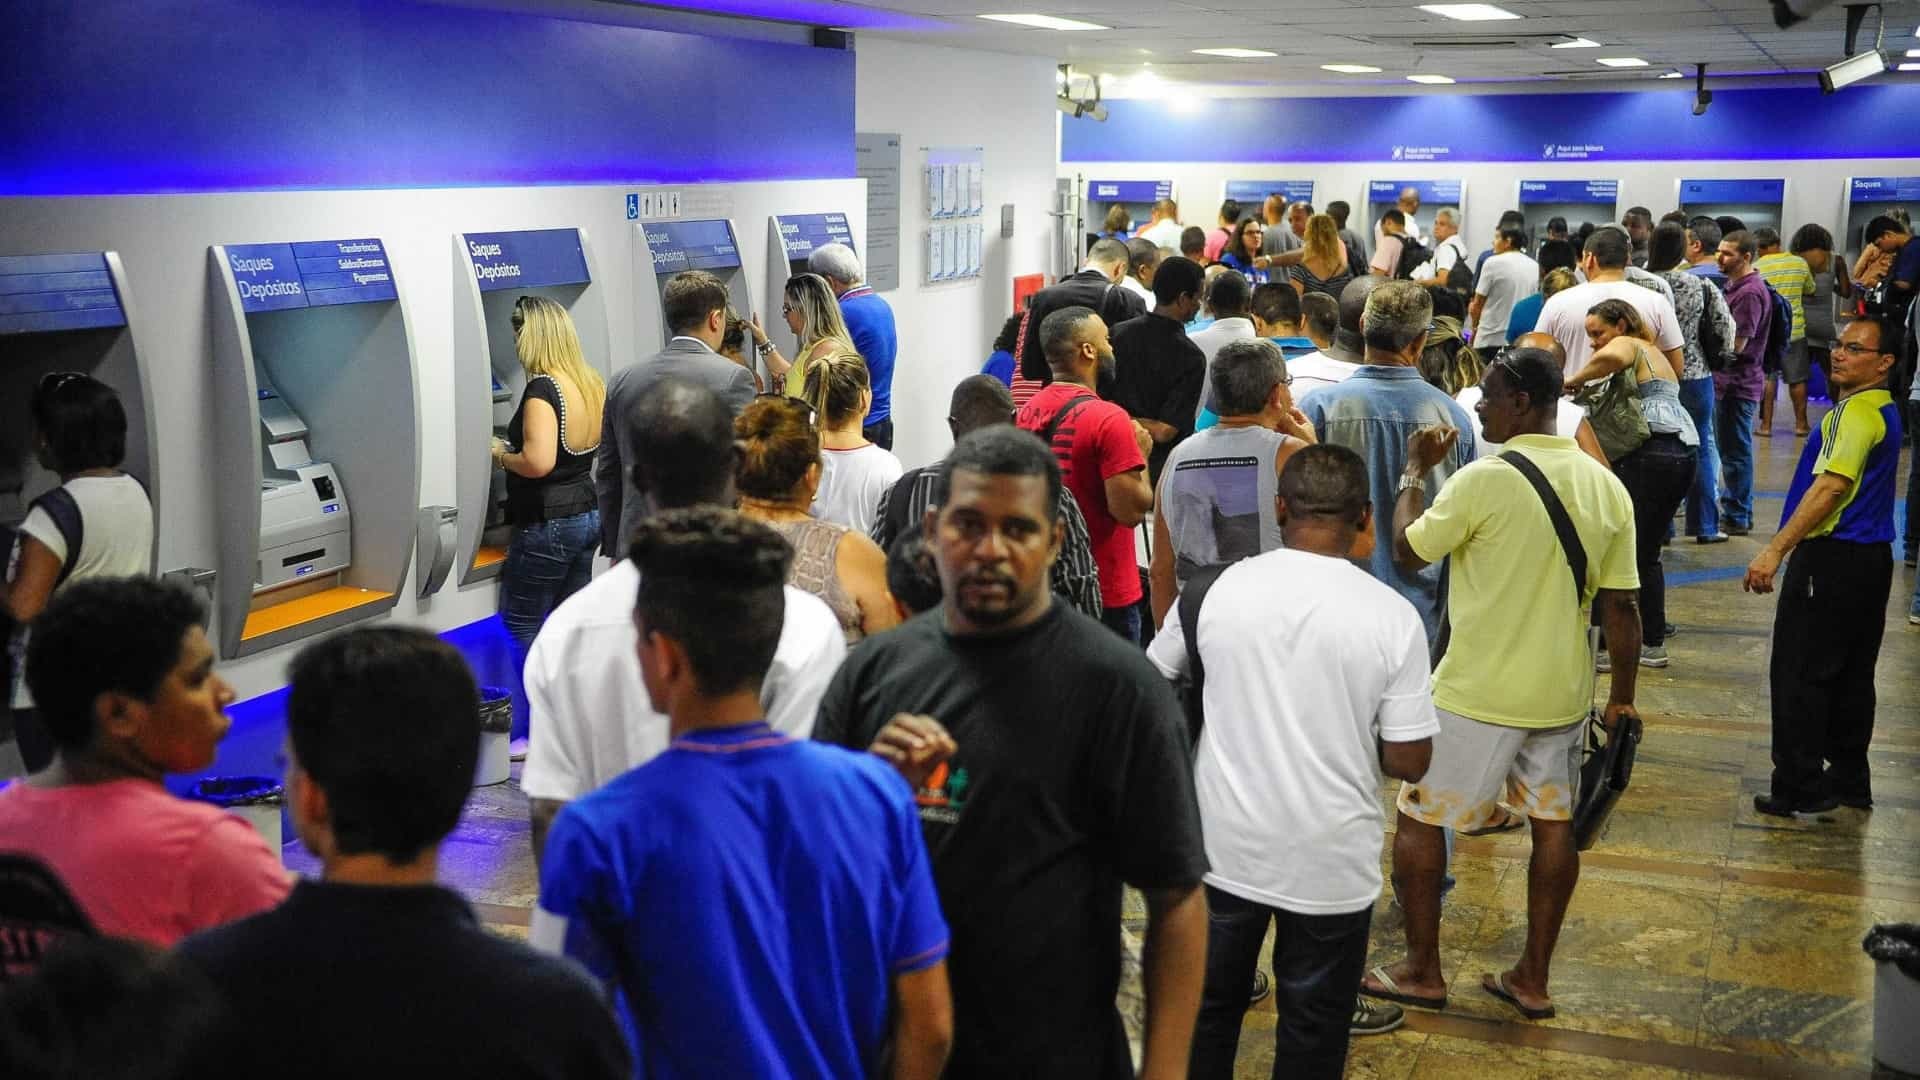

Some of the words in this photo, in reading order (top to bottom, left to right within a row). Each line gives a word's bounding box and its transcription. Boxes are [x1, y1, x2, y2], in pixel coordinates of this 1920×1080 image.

[1855, 181, 1881, 189] Saques
[645, 230, 670, 246] Saques
[469, 241, 502, 260] Saques
[650, 249, 686, 264] Depósitos
[230, 254, 274, 276] Saques
[475, 263, 521, 282] Depósitos
[239, 279, 301, 302] Depósitos
